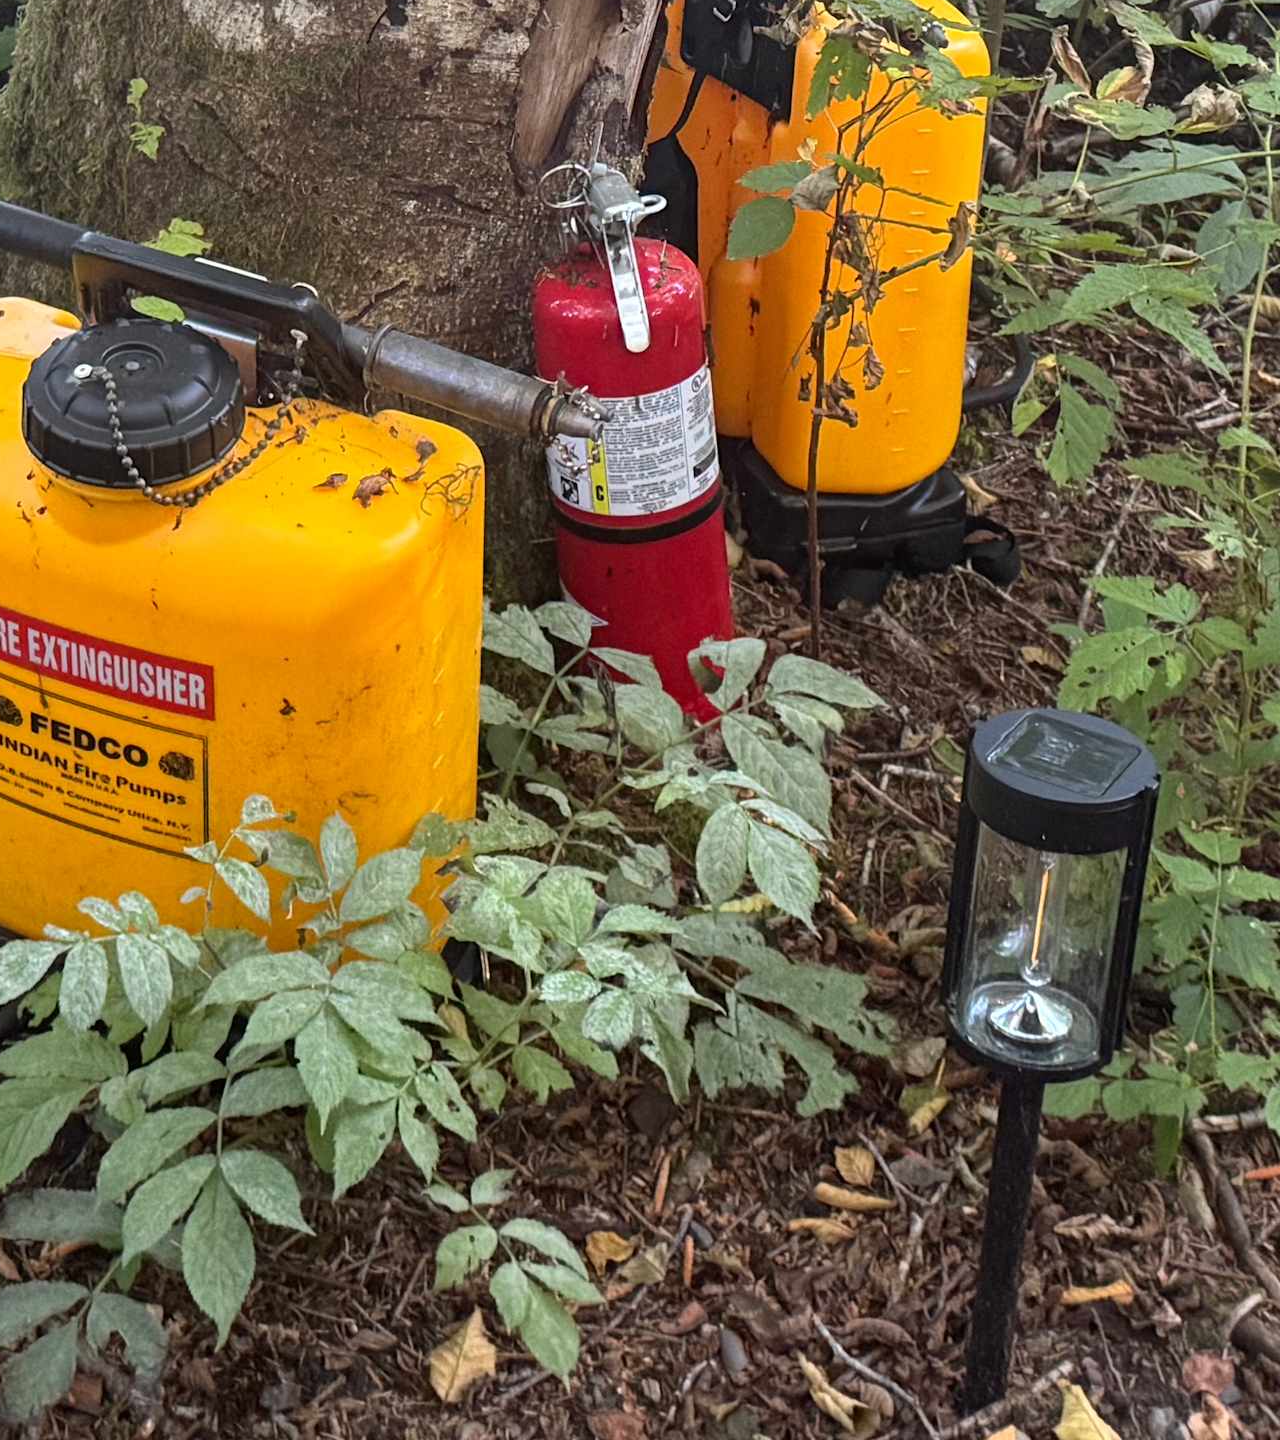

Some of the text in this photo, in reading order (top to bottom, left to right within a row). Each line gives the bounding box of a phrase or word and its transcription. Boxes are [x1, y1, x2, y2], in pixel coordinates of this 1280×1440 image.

[595, 485, 605, 501] C
[27, 627, 206, 710] EXTINGUISHER
[30, 711, 150, 768] FEDCO
[66, 789, 125, 814] Company
[116, 775, 187, 806] Pumps
